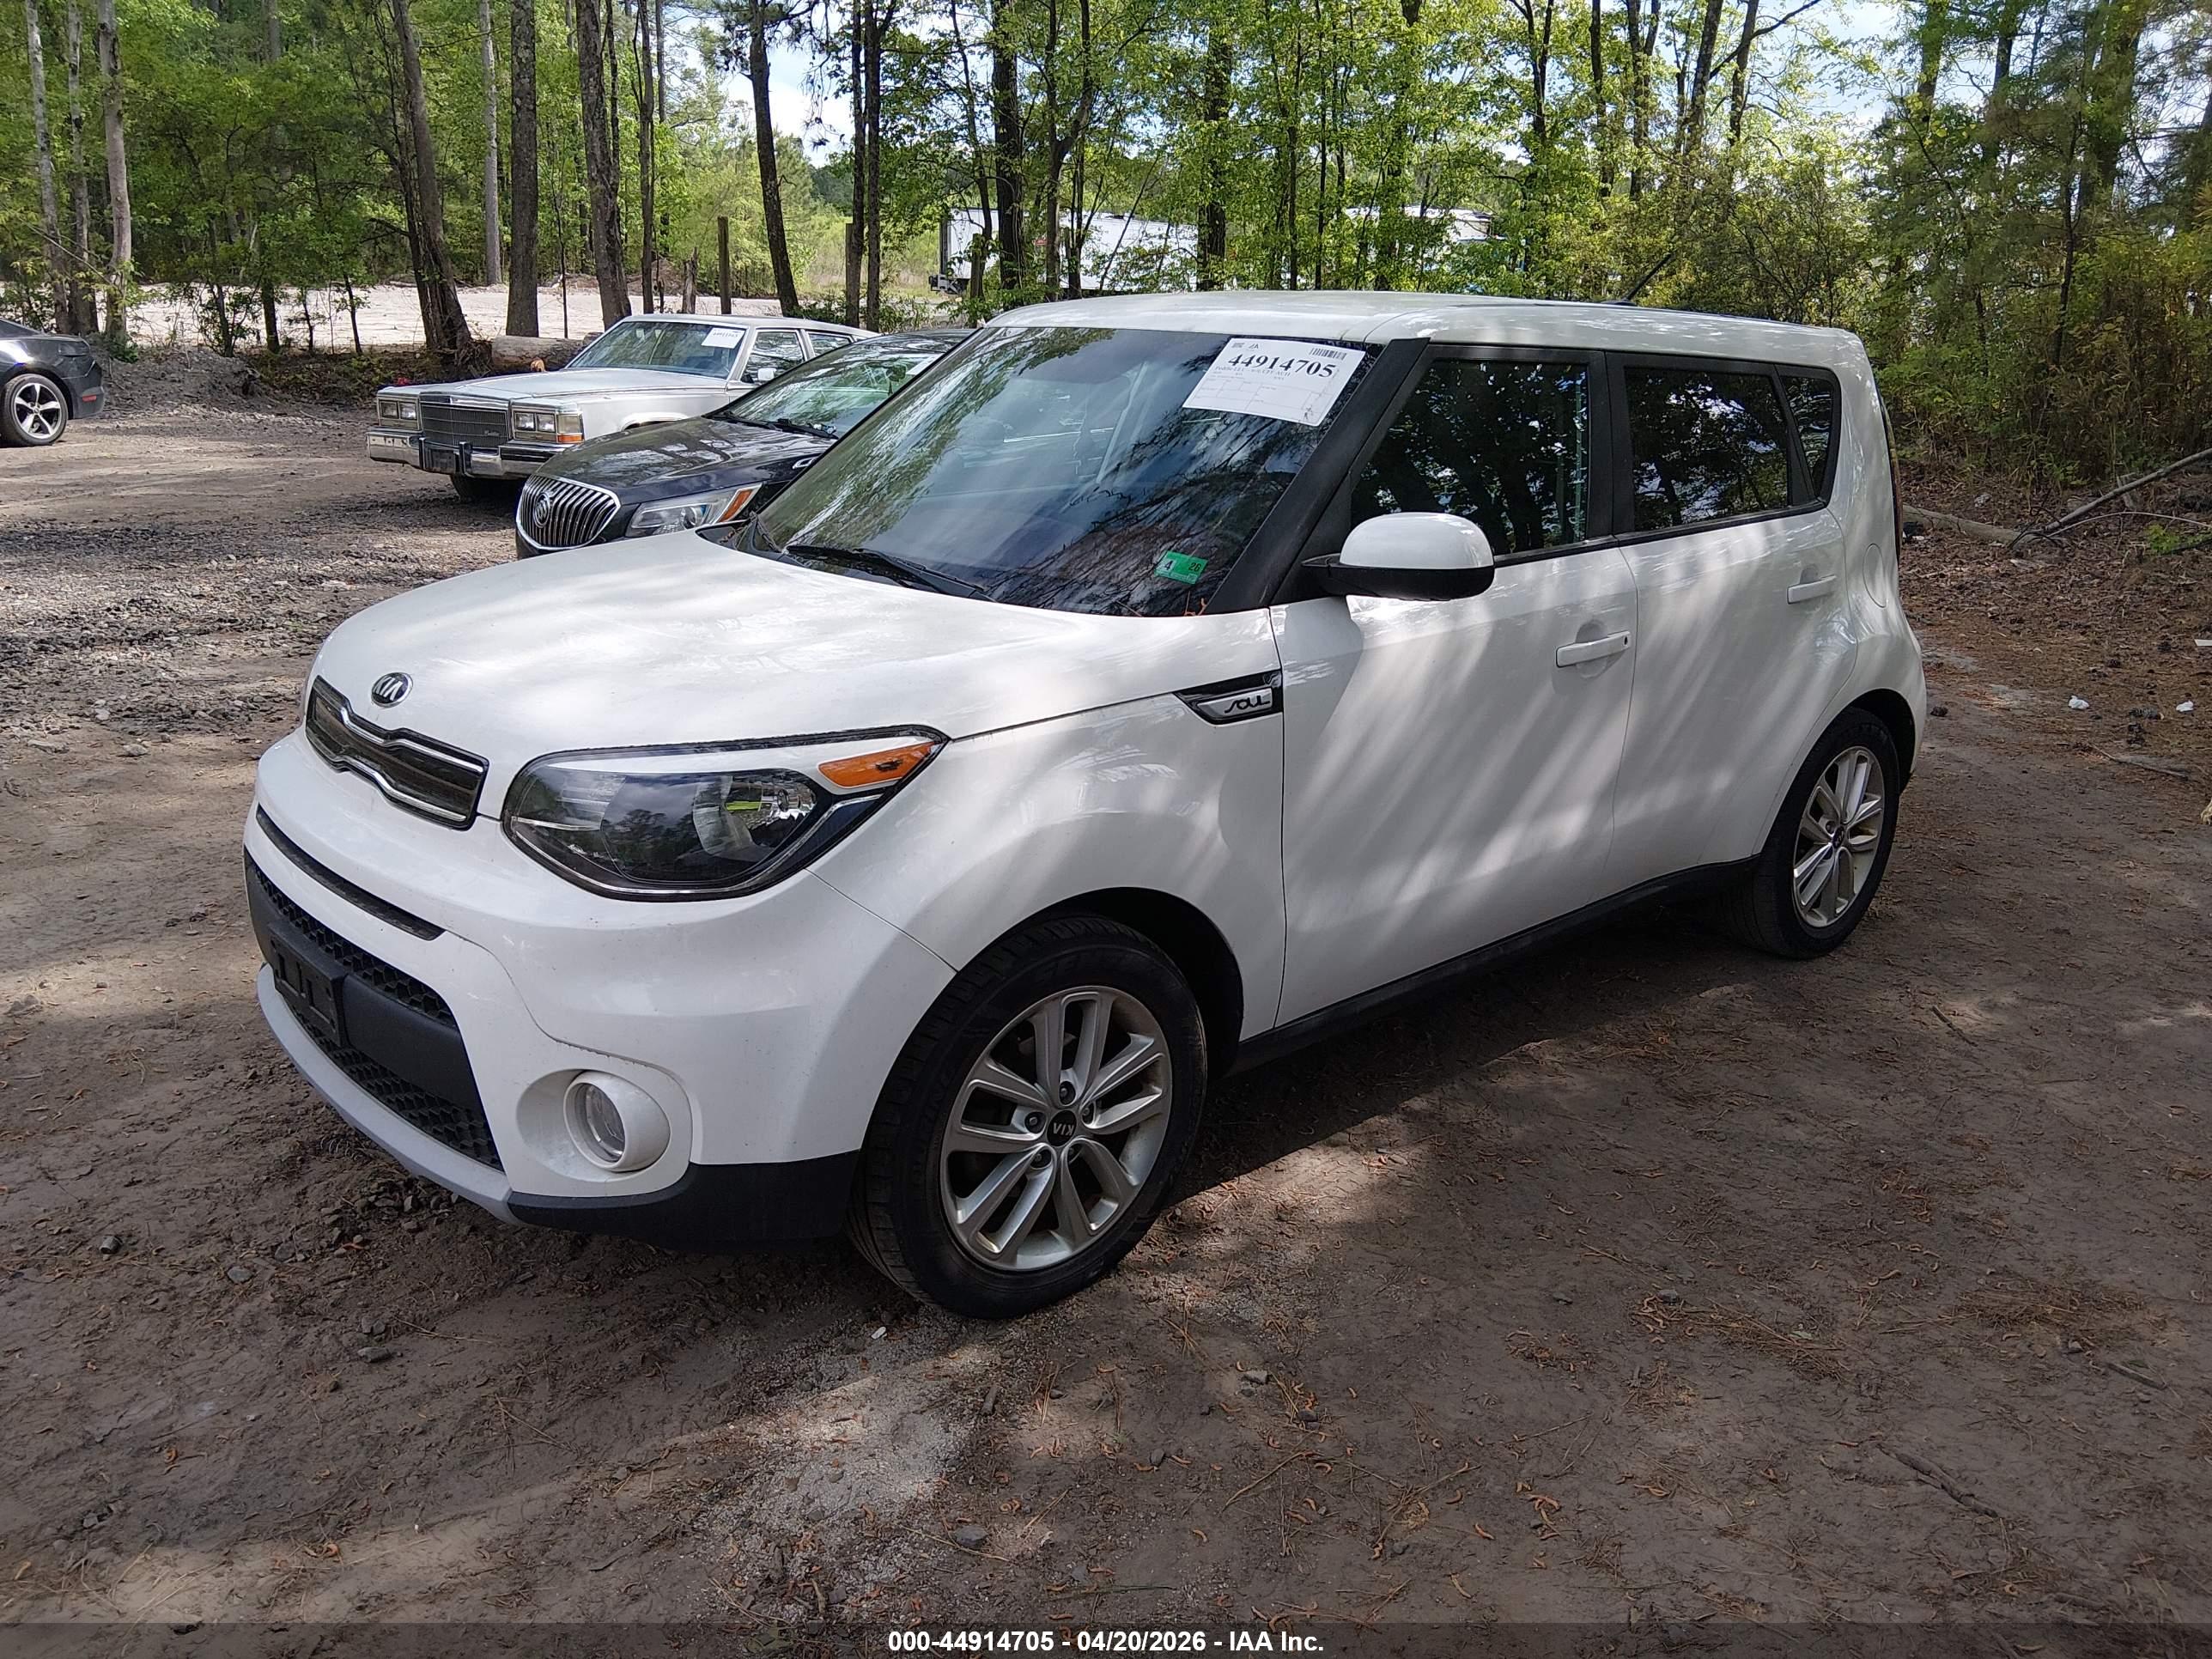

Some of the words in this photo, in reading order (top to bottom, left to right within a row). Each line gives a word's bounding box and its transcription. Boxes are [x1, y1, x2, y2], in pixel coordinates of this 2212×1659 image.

[1228, 354, 1336, 378] 44914705
[1164, 560, 1174, 571] 4
[1188, 562, 1202, 572] 26
[373, 675, 404, 701] KIA
[1053, 1122, 1075, 1136] KIA
